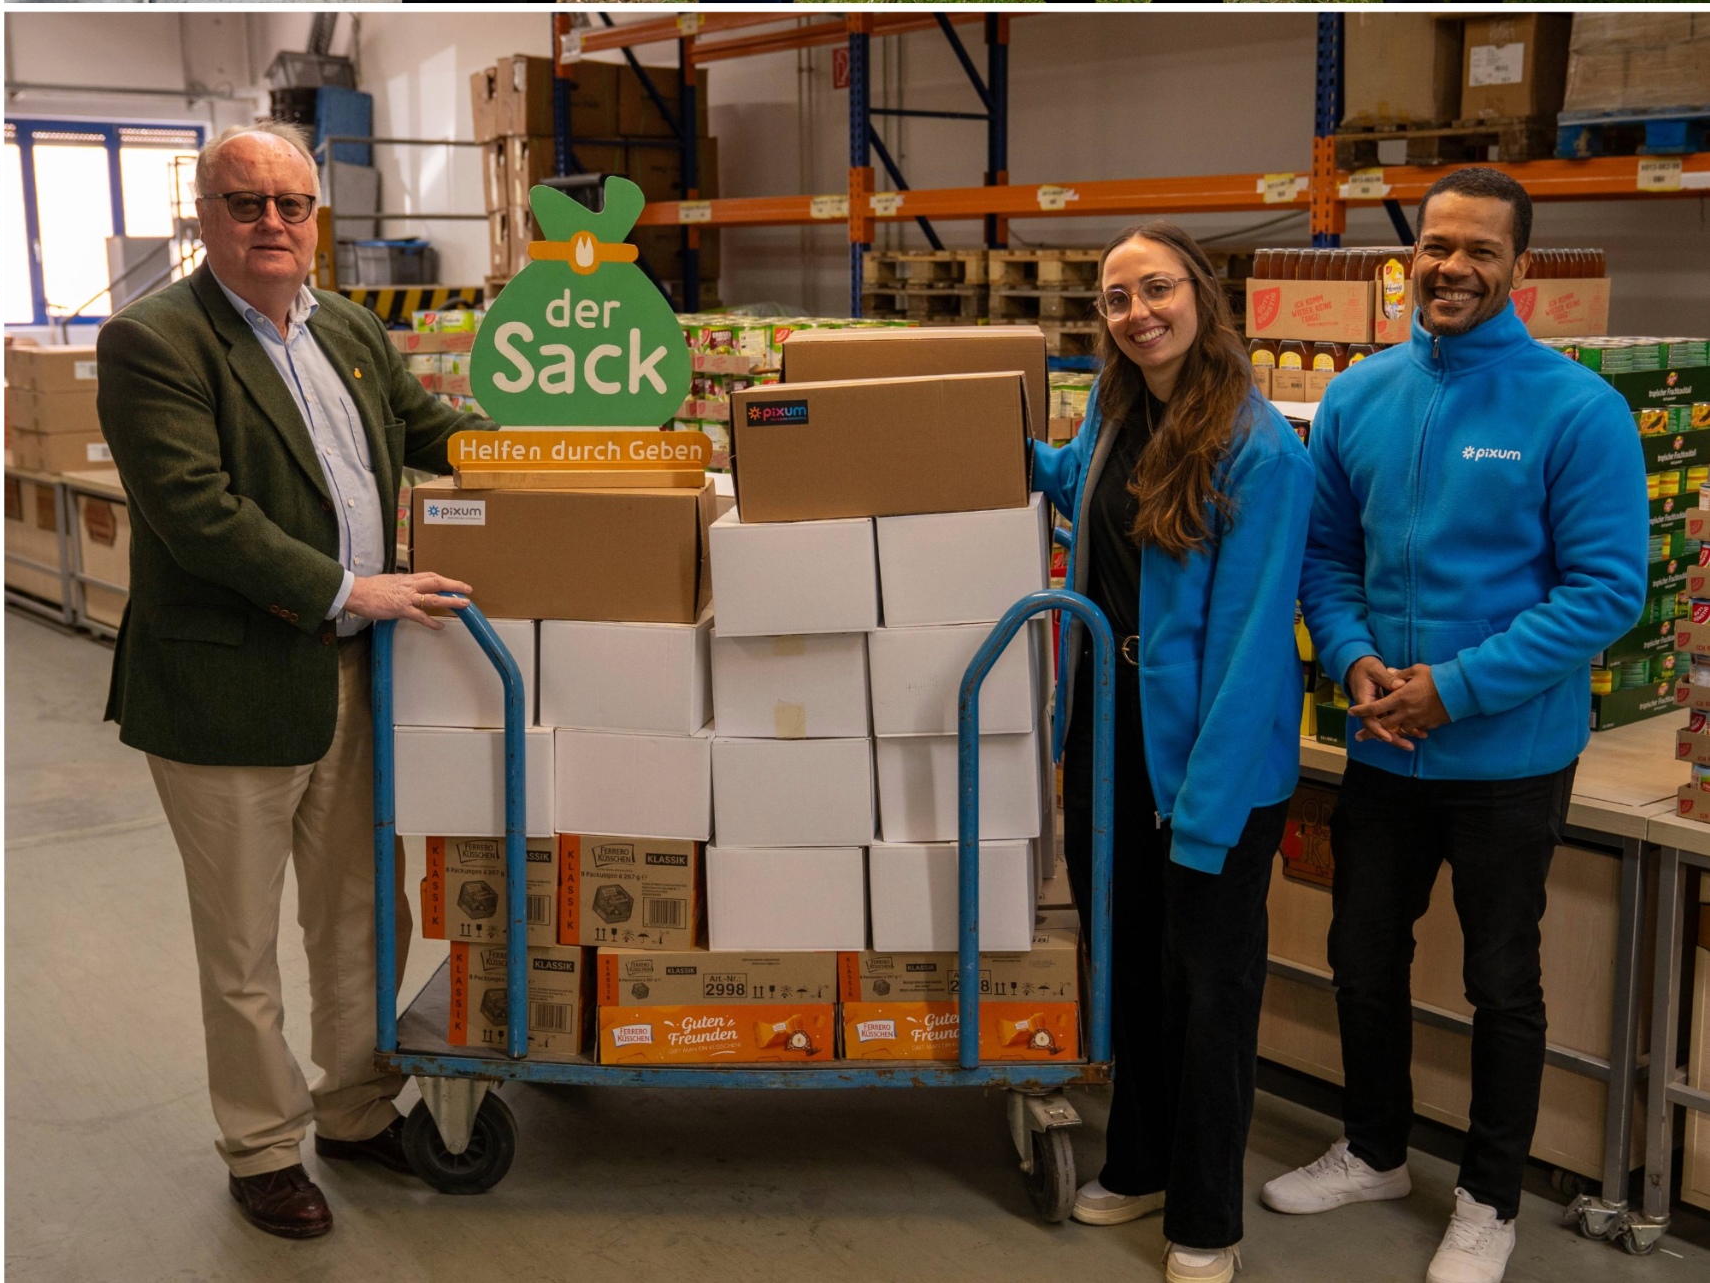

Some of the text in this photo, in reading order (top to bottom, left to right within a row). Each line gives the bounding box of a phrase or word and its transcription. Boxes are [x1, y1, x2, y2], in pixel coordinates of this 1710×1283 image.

[546, 288, 621, 328] der
[492, 321, 668, 395] Sack
[763, 406, 807, 421] pixum
[460, 440, 702, 461] Helfen durch Geben
[1475, 446, 1521, 462] pixum
[441, 507, 482, 519] pixum
[647, 854, 686, 865] KLASSIK
[431, 846, 439, 926] KLASSIK
[567, 849, 575, 931] KLASSIK
[534, 960, 573, 971] KLASSIK
[455, 954, 463, 1031] KLASSIK
[705, 982, 745, 996] 2998
[682, 1016, 724, 1032] Guten
[668, 1028, 739, 1046] Freunden
